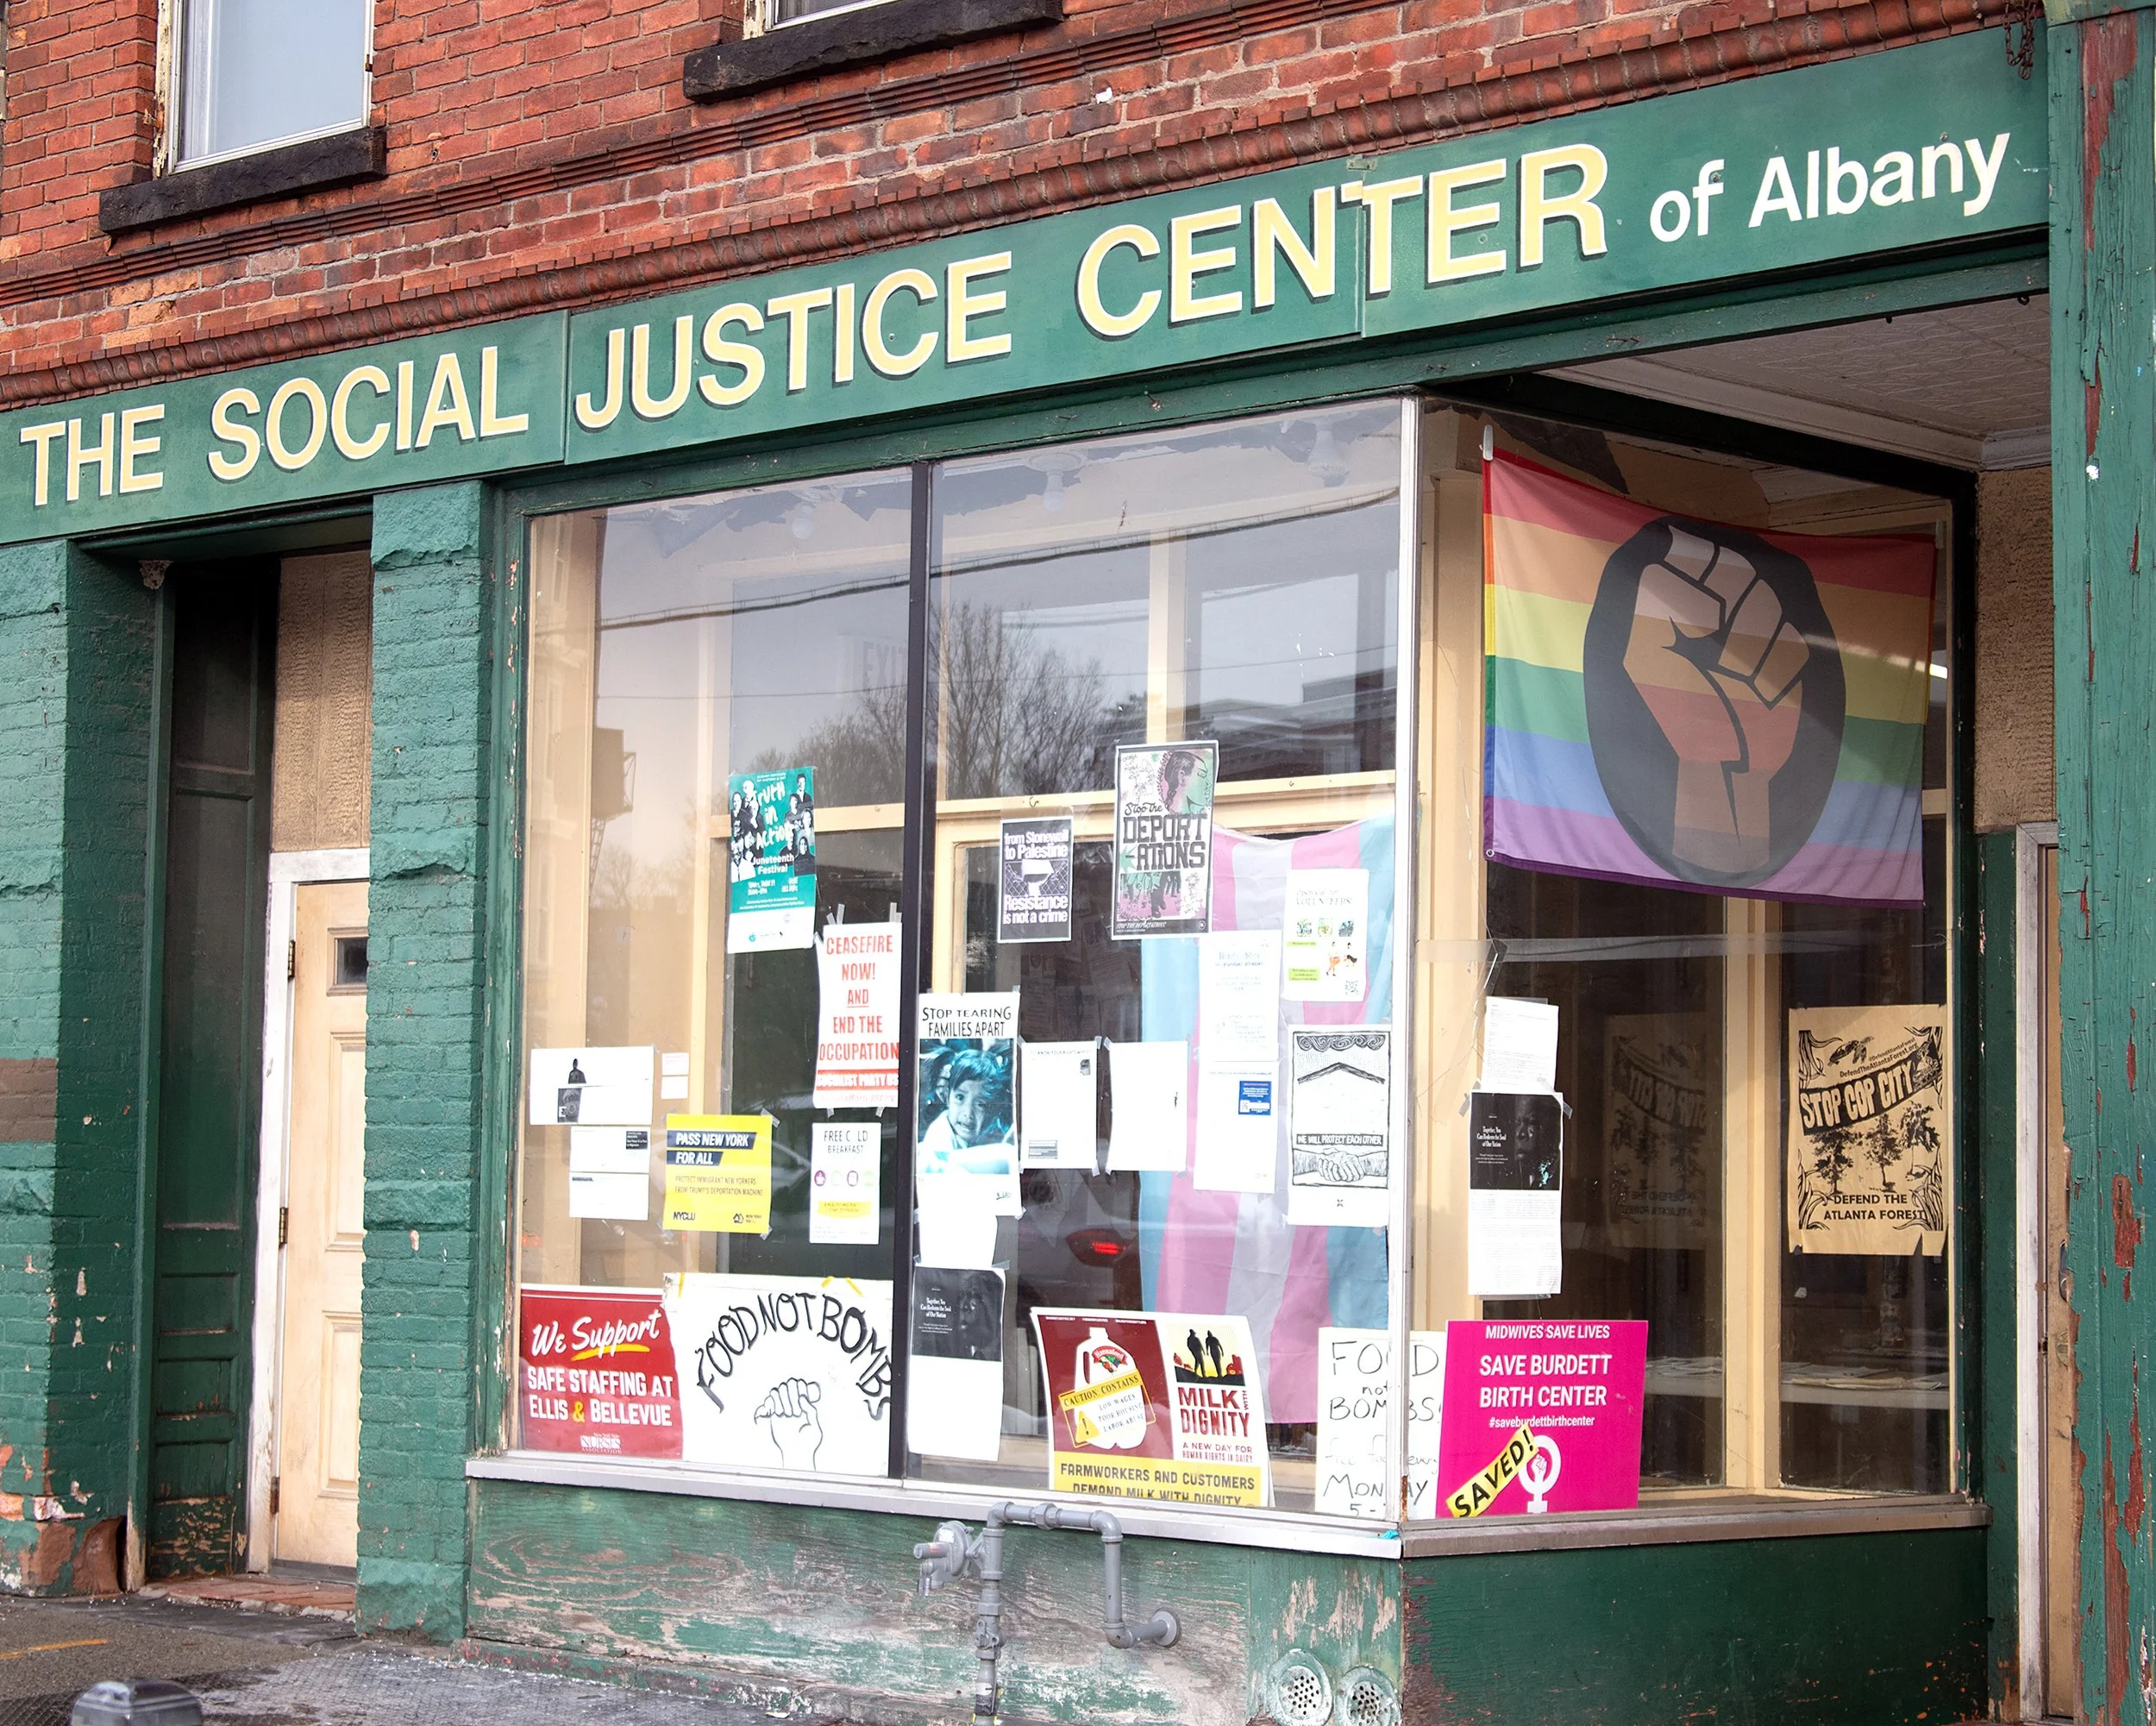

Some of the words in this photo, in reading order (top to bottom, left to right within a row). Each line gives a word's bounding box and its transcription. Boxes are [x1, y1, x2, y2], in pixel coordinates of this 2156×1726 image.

[20, 403, 165, 506] THE
[208, 346, 529, 481] SOCIAL
[575, 248, 1012, 428] JUSTICE
[1077, 143, 1608, 336] CENTER
[1649, 159, 1725, 242] of
[1748, 132, 2010, 224] Albany
[1004, 833, 1025, 844] from
[1025, 829, 1069, 844] Stonewall
[1123, 813, 1207, 844] DEPORT
[753, 853, 794, 865] Juneteenth
[1005, 845, 1016, 860] to
[1017, 843, 1069, 859] Palestine
[758, 863, 788, 875] Festival
[1004, 894, 1069, 911] Resistance
[1003, 911, 1012, 925] is
[1012, 910, 1029, 924] not
[1030, 912, 1037, 923] a
[1038, 909, 1069, 923] crime
[826, 935, 893, 955] CEASEFIRE
[842, 962, 876, 981] NOW!
[847, 989, 868, 1006] AND
[922, 1007, 952, 1020] STOP
[957, 1006, 1012, 1020] TEARING
[833, 1016, 855, 1034] END
[859, 1015, 883, 1033] THE
[928, 1021, 973, 1038] FAMILIES
[975, 1021, 1006, 1037] APART
[819, 1042, 899, 1061] OCCUPATION
[1839, 1043, 1919, 1078] DefendTheAtlantaForest.org
[1800, 1088, 1841, 1129] STOP
[1844, 1078, 1876, 1120] COP
[1877, 1060, 1914, 1109] CITY
[675, 1133, 701, 1145] PASS
[701, 1133, 724, 1146] NEW
[725, 1133, 749, 1147] YORK
[824, 1130, 843, 1142] FREE
[846, 1130, 868, 1142] CLD
[1297, 1135, 1307, 1144] WE
[1307, 1135, 1321, 1145] WILL
[1321, 1135, 1346, 1145] PROTECT
[1346, 1135, 1362, 1145] EACH
[1362, 1136, 1382, 1145] OTHER
[675, 1152, 696, 1164] FOR
[696, 1152, 714, 1165] ALL
[1833, 1194, 1880, 1205] DEFEND
[1883, 1194, 1908, 1204] THE
[673, 1211, 695, 1221] NYCLU
[1824, 1210, 1876, 1221] ATLANTA
[1879, 1209, 1925, 1220] FOREST
[531, 1321, 567, 1357] We
[571, 1309, 662, 1359] Support
[1485, 1325, 1544, 1339] MIDWIVES
[1545, 1325, 1576, 1339] SAVE
[1577, 1325, 1610, 1339] LIVES
[695, 1305, 759, 1414] FOOD
[757, 1292, 817, 1335] NOT
[1094, 1347, 1125, 1359] Hannaford
[1332, 1340, 1439, 1377] FOD
[1479, 1354, 1526, 1376] SAVE
[1530, 1353, 1613, 1375] BURDETT
[528, 1366, 566, 1392] SAFE
[569, 1369, 647, 1396] STAFFING
[651, 1376, 674, 1397] AT
[1100, 1375, 1140, 1395] CONTAINS
[1362, 1380, 1388, 1395] not
[1099, 1401, 1112, 1411] LOW
[1114, 1393, 1136, 1404] WAGES
[1178, 1387, 1240, 1409] MILK
[1479, 1387, 1533, 1408] BIRTH
[1538, 1385, 1608, 1407] CENTER
[529, 1395, 568, 1421] ELLIS
[572, 1401, 586, 1422] &
[590, 1399, 673, 1426] BELLEVUE
[1098, 1412, 1114, 1422] POOR
[1116, 1403, 1144, 1415] HOUSING
[1103, 1421, 1124, 1432] LABOR
[1125, 1414, 1144, 1425] ABUSE
[1181, 1409, 1250, 1437] DIGNITY
[1489, 1415, 1595, 1428] #saveburdettbirthcenter
[1182, 1451, 1202, 1459] HUMAN
[1205, 1452, 1225, 1462] RIGHTS
[1227, 1453, 1233, 1462] IN
[1236, 1454, 1253, 1463] DAIRY
[1061, 1463, 1150, 1482] FARMWORKERS
[1154, 1471, 1178, 1484] AND
[1182, 1472, 1255, 1491] CUSTOMERS
[1454, 1428, 1534, 1518] SAVED!
[1160, 1490, 1189, 1502] WITH
[1194, 1494, 1242, 1505] DIGNITY
